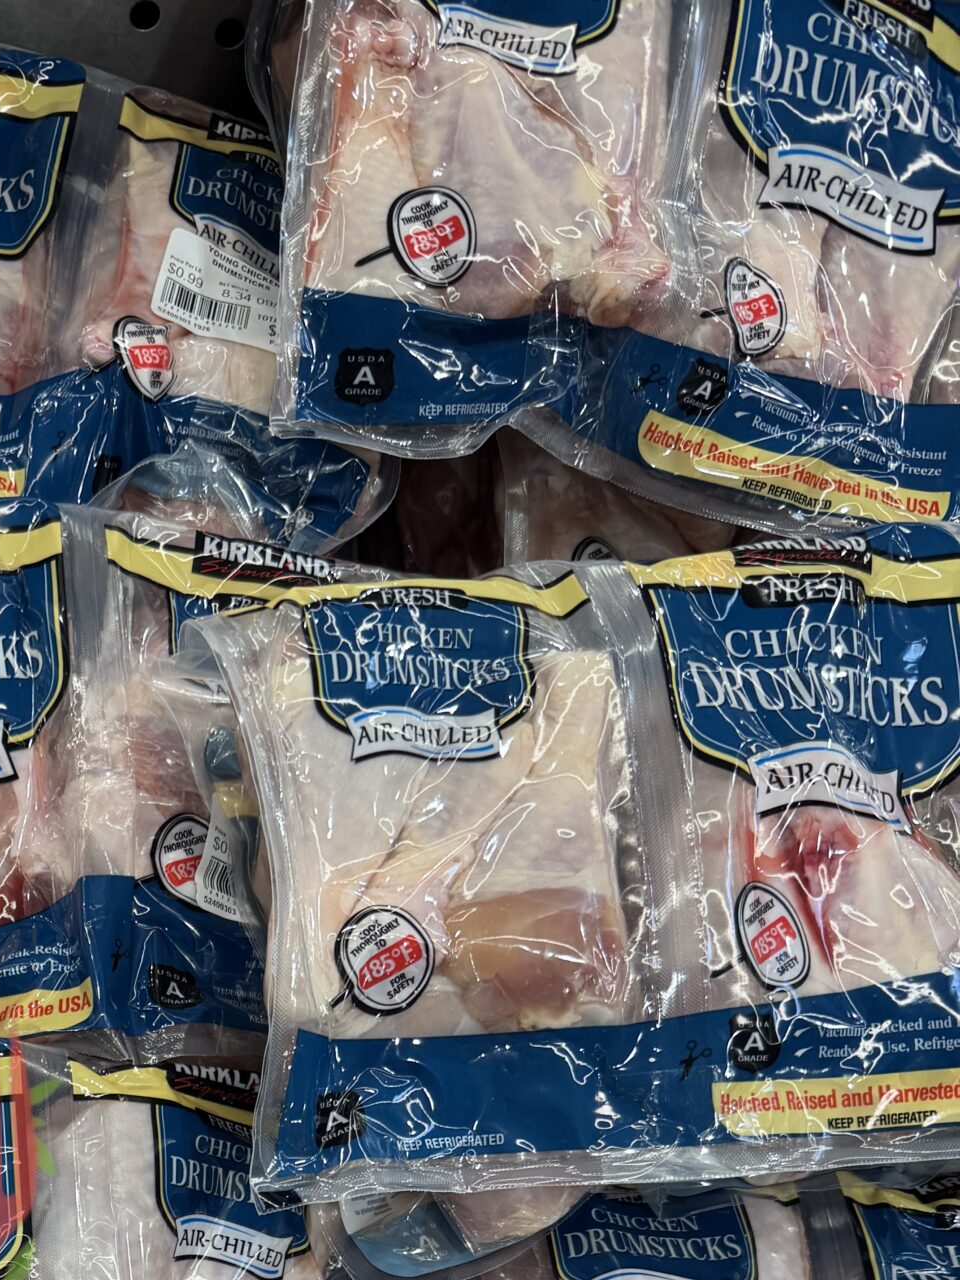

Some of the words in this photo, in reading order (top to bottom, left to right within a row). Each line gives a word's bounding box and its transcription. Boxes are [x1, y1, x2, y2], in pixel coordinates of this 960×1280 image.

[444, 18, 567, 61] AIR-CHILLED
[773, 164, 928, 231] AIR-CHILLED
[208, 245, 239, 269] YOUNG
[167, 262, 204, 289] $0.99
[221, 289, 251, 302] 8.34
[212, 259, 271, 291] DRUMSTICKS
[353, 366, 375, 386] A
[419, 404, 442, 416] KEEP
[445, 402, 508, 415] REFRIGERATED
[742, 477, 767, 493] KEEP
[769, 578, 856, 603] FRESH
[357, 622, 474, 649] CHICKEN
[724, 622, 883, 665] CHICKEN
[330, 651, 511, 691] DRUMSTICKS
[687, 660, 949, 728] DRUMSTICKS
[358, 722, 493, 745] AIR-CHILLED
[350, 917, 401, 957] THOROUGHLY
[361, 940, 414, 982] 185°F
[386, 976, 416, 1000] SAFETY
[389, 972, 407, 988] FOR
[58, 991, 92, 1013] USA
[591, 1207, 699, 1232] CHICKEN
[179, 1228, 283, 1269] AIR-CHILLED
[564, 1230, 742, 1261] DRUMSTICKS
